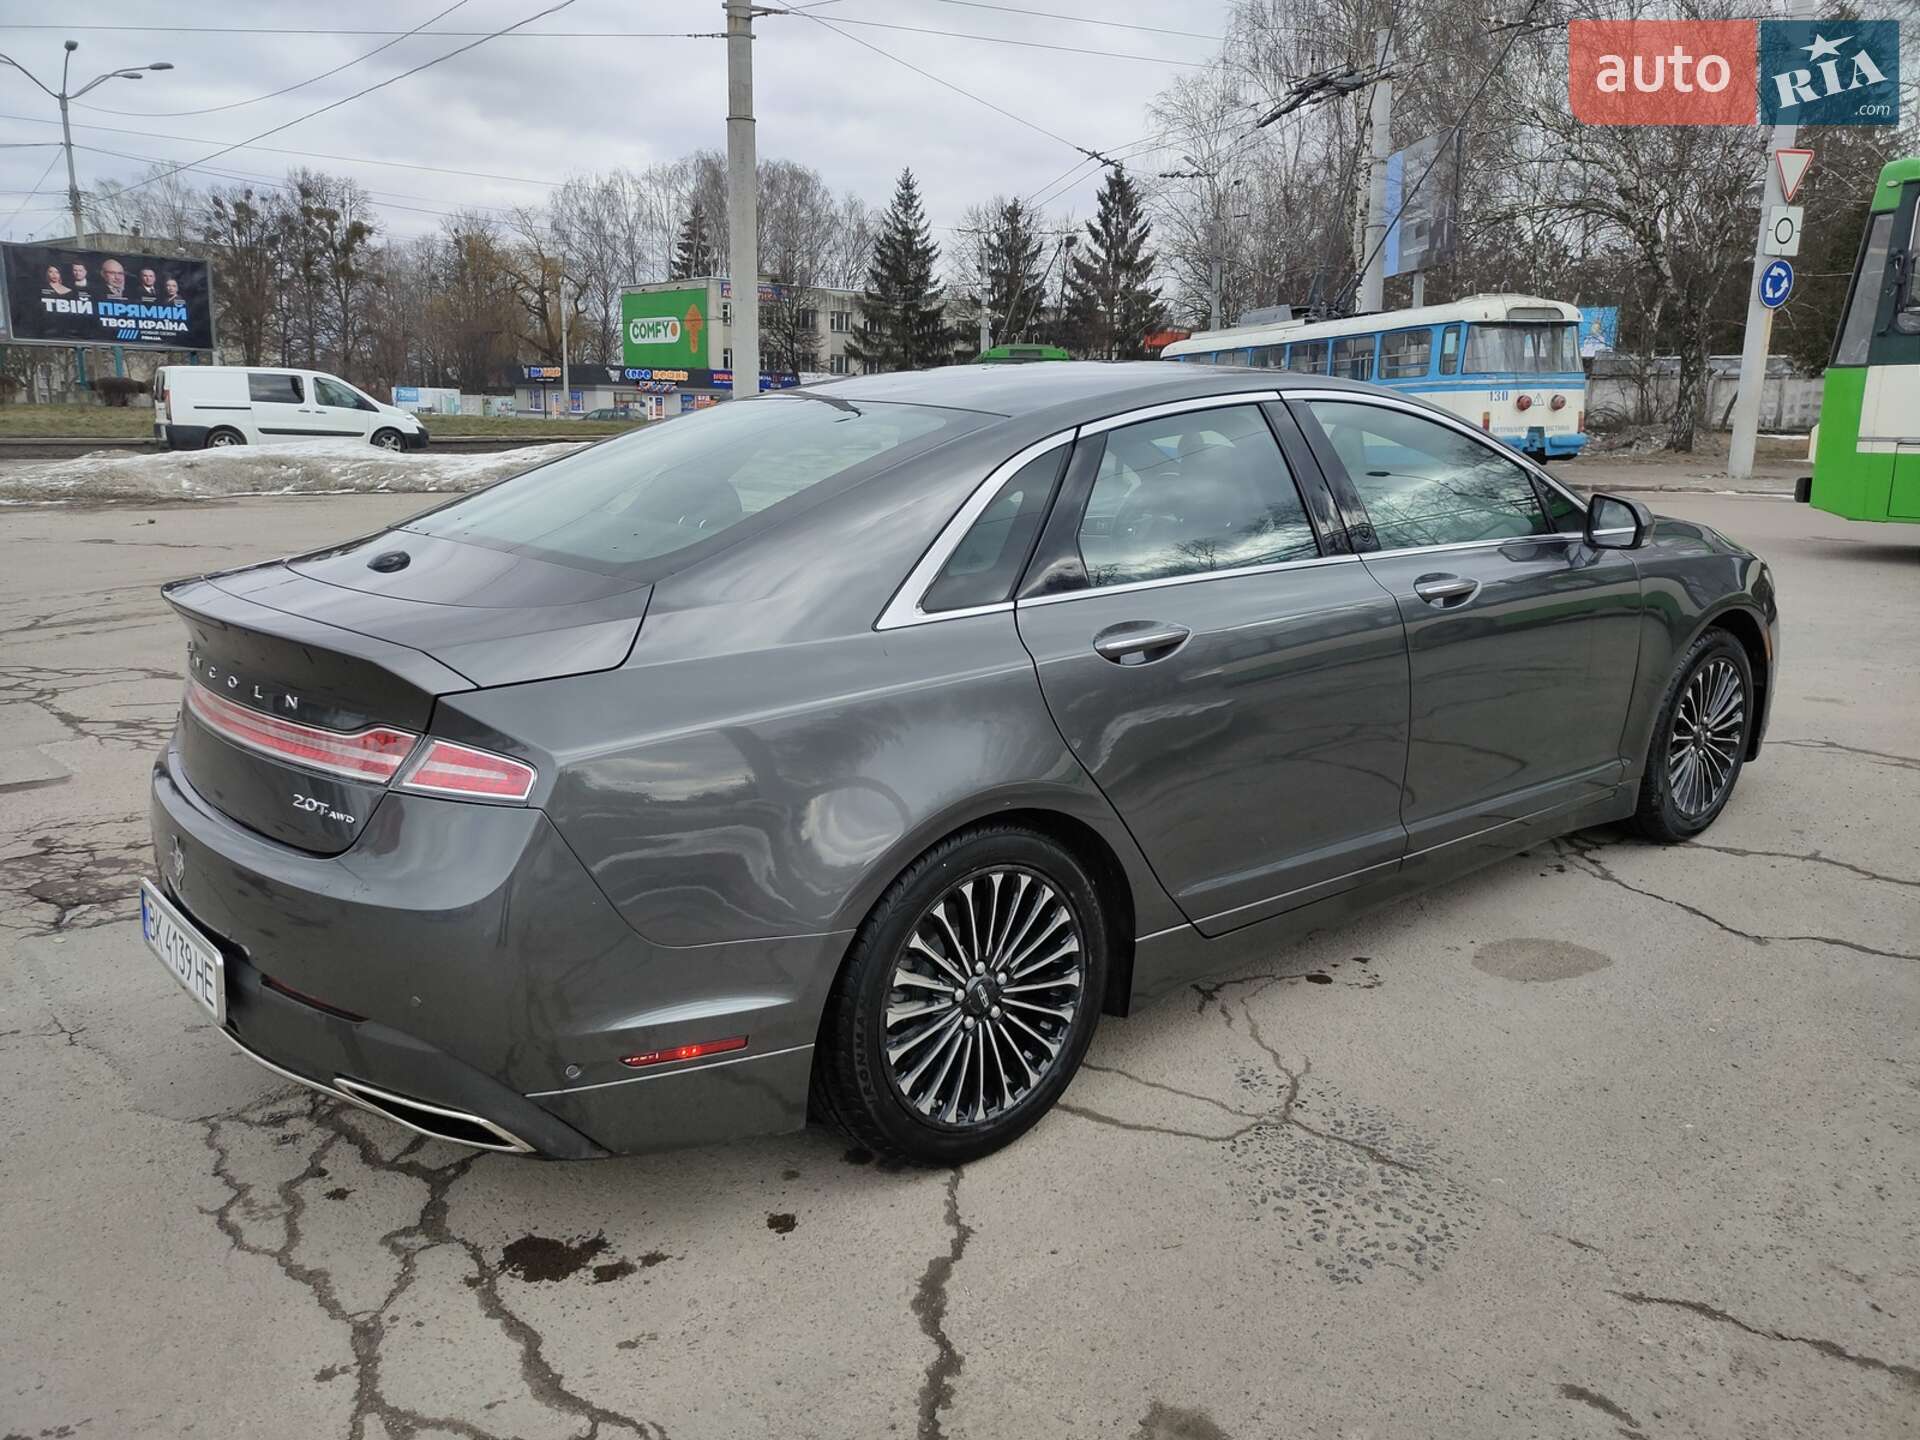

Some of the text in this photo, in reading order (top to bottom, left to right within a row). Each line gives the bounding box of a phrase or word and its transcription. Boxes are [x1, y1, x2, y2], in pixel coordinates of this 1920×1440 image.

[41, 296, 188, 321] ТВІЙ ПРЯМИЙ
[100, 317, 188, 332] ТВОЯ КРАЇНА
[632, 321, 670, 340] COMFY
[328, 811, 355, 824] AWD
[165, 922, 193, 982] 4139
[195, 950, 215, 1008] HE
